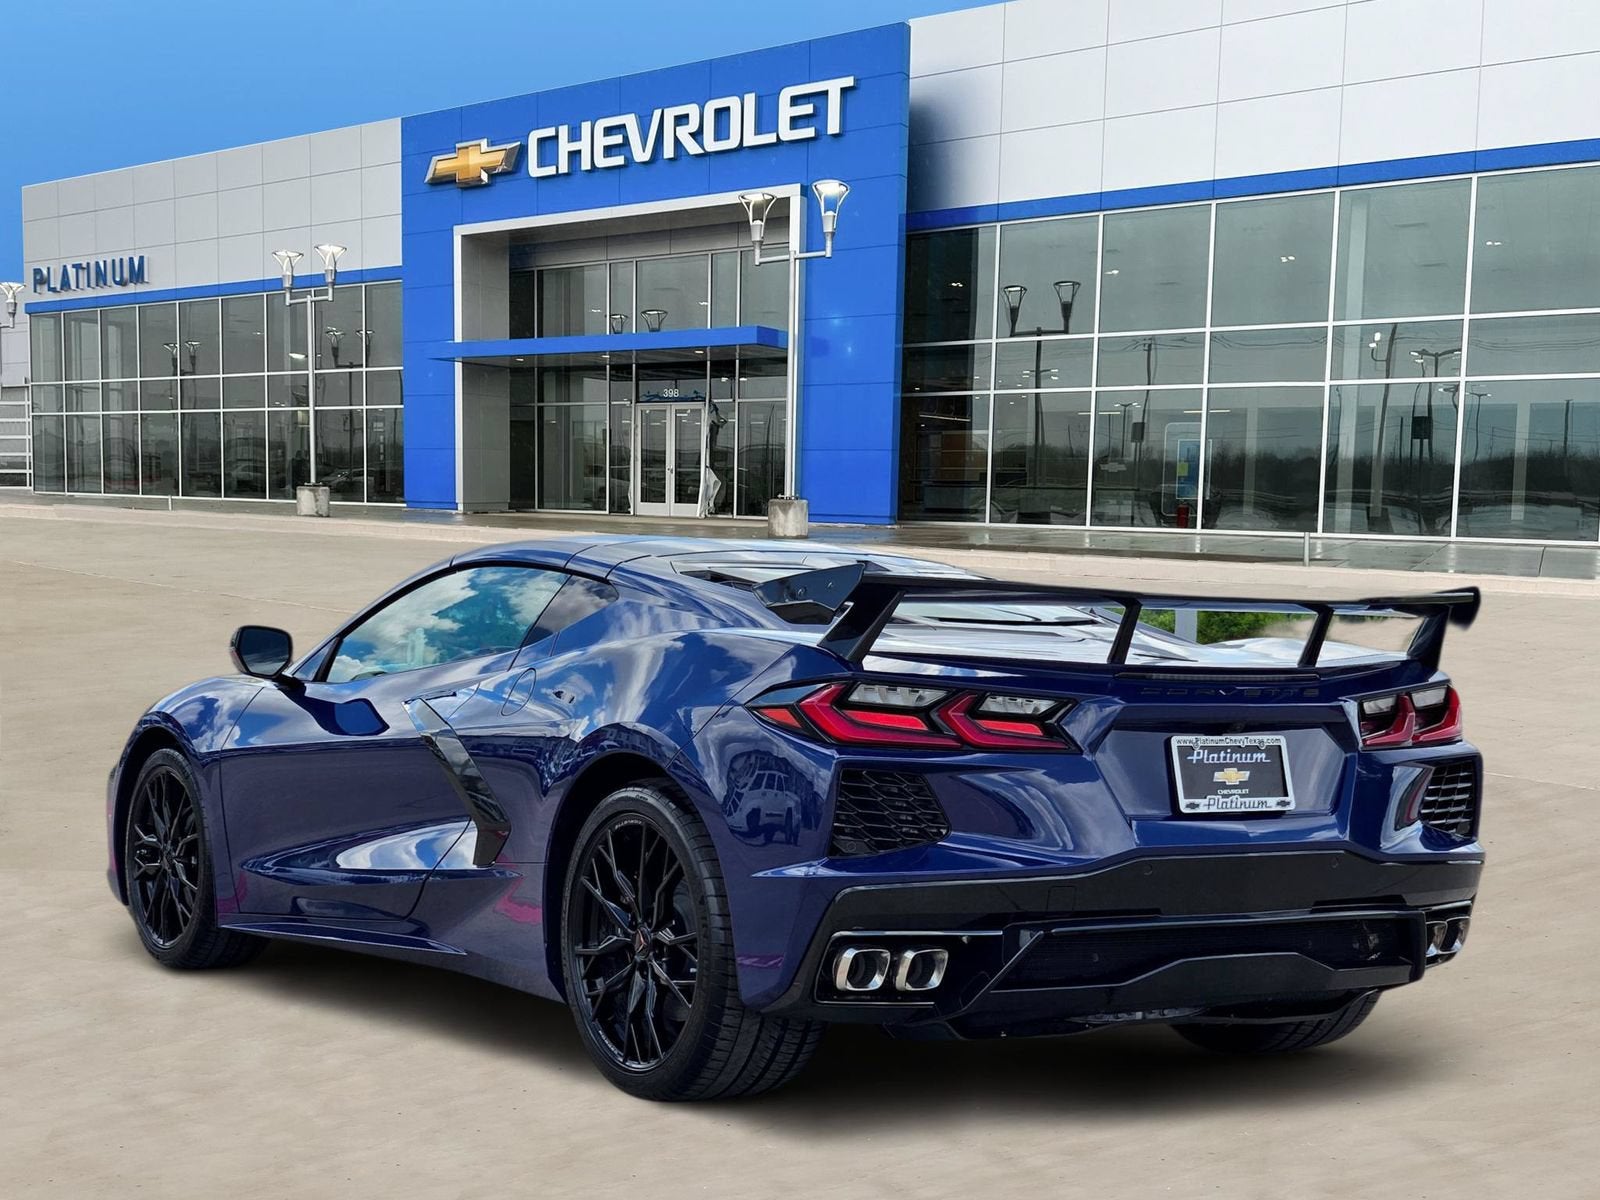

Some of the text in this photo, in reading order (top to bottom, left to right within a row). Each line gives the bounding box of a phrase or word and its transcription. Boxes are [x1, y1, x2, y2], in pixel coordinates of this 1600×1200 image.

[527, 75, 855, 177] CHEVROLET
[33, 255, 146, 293] PLATINUM
[663, 388, 679, 398] 398
[1176, 737, 1282, 746] www.PlatinumChevyTexas.com
[1187, 749, 1271, 764] Platinum
[1217, 788, 1249, 796] CHEVROLET
[1203, 796, 1272, 810] Platinum
